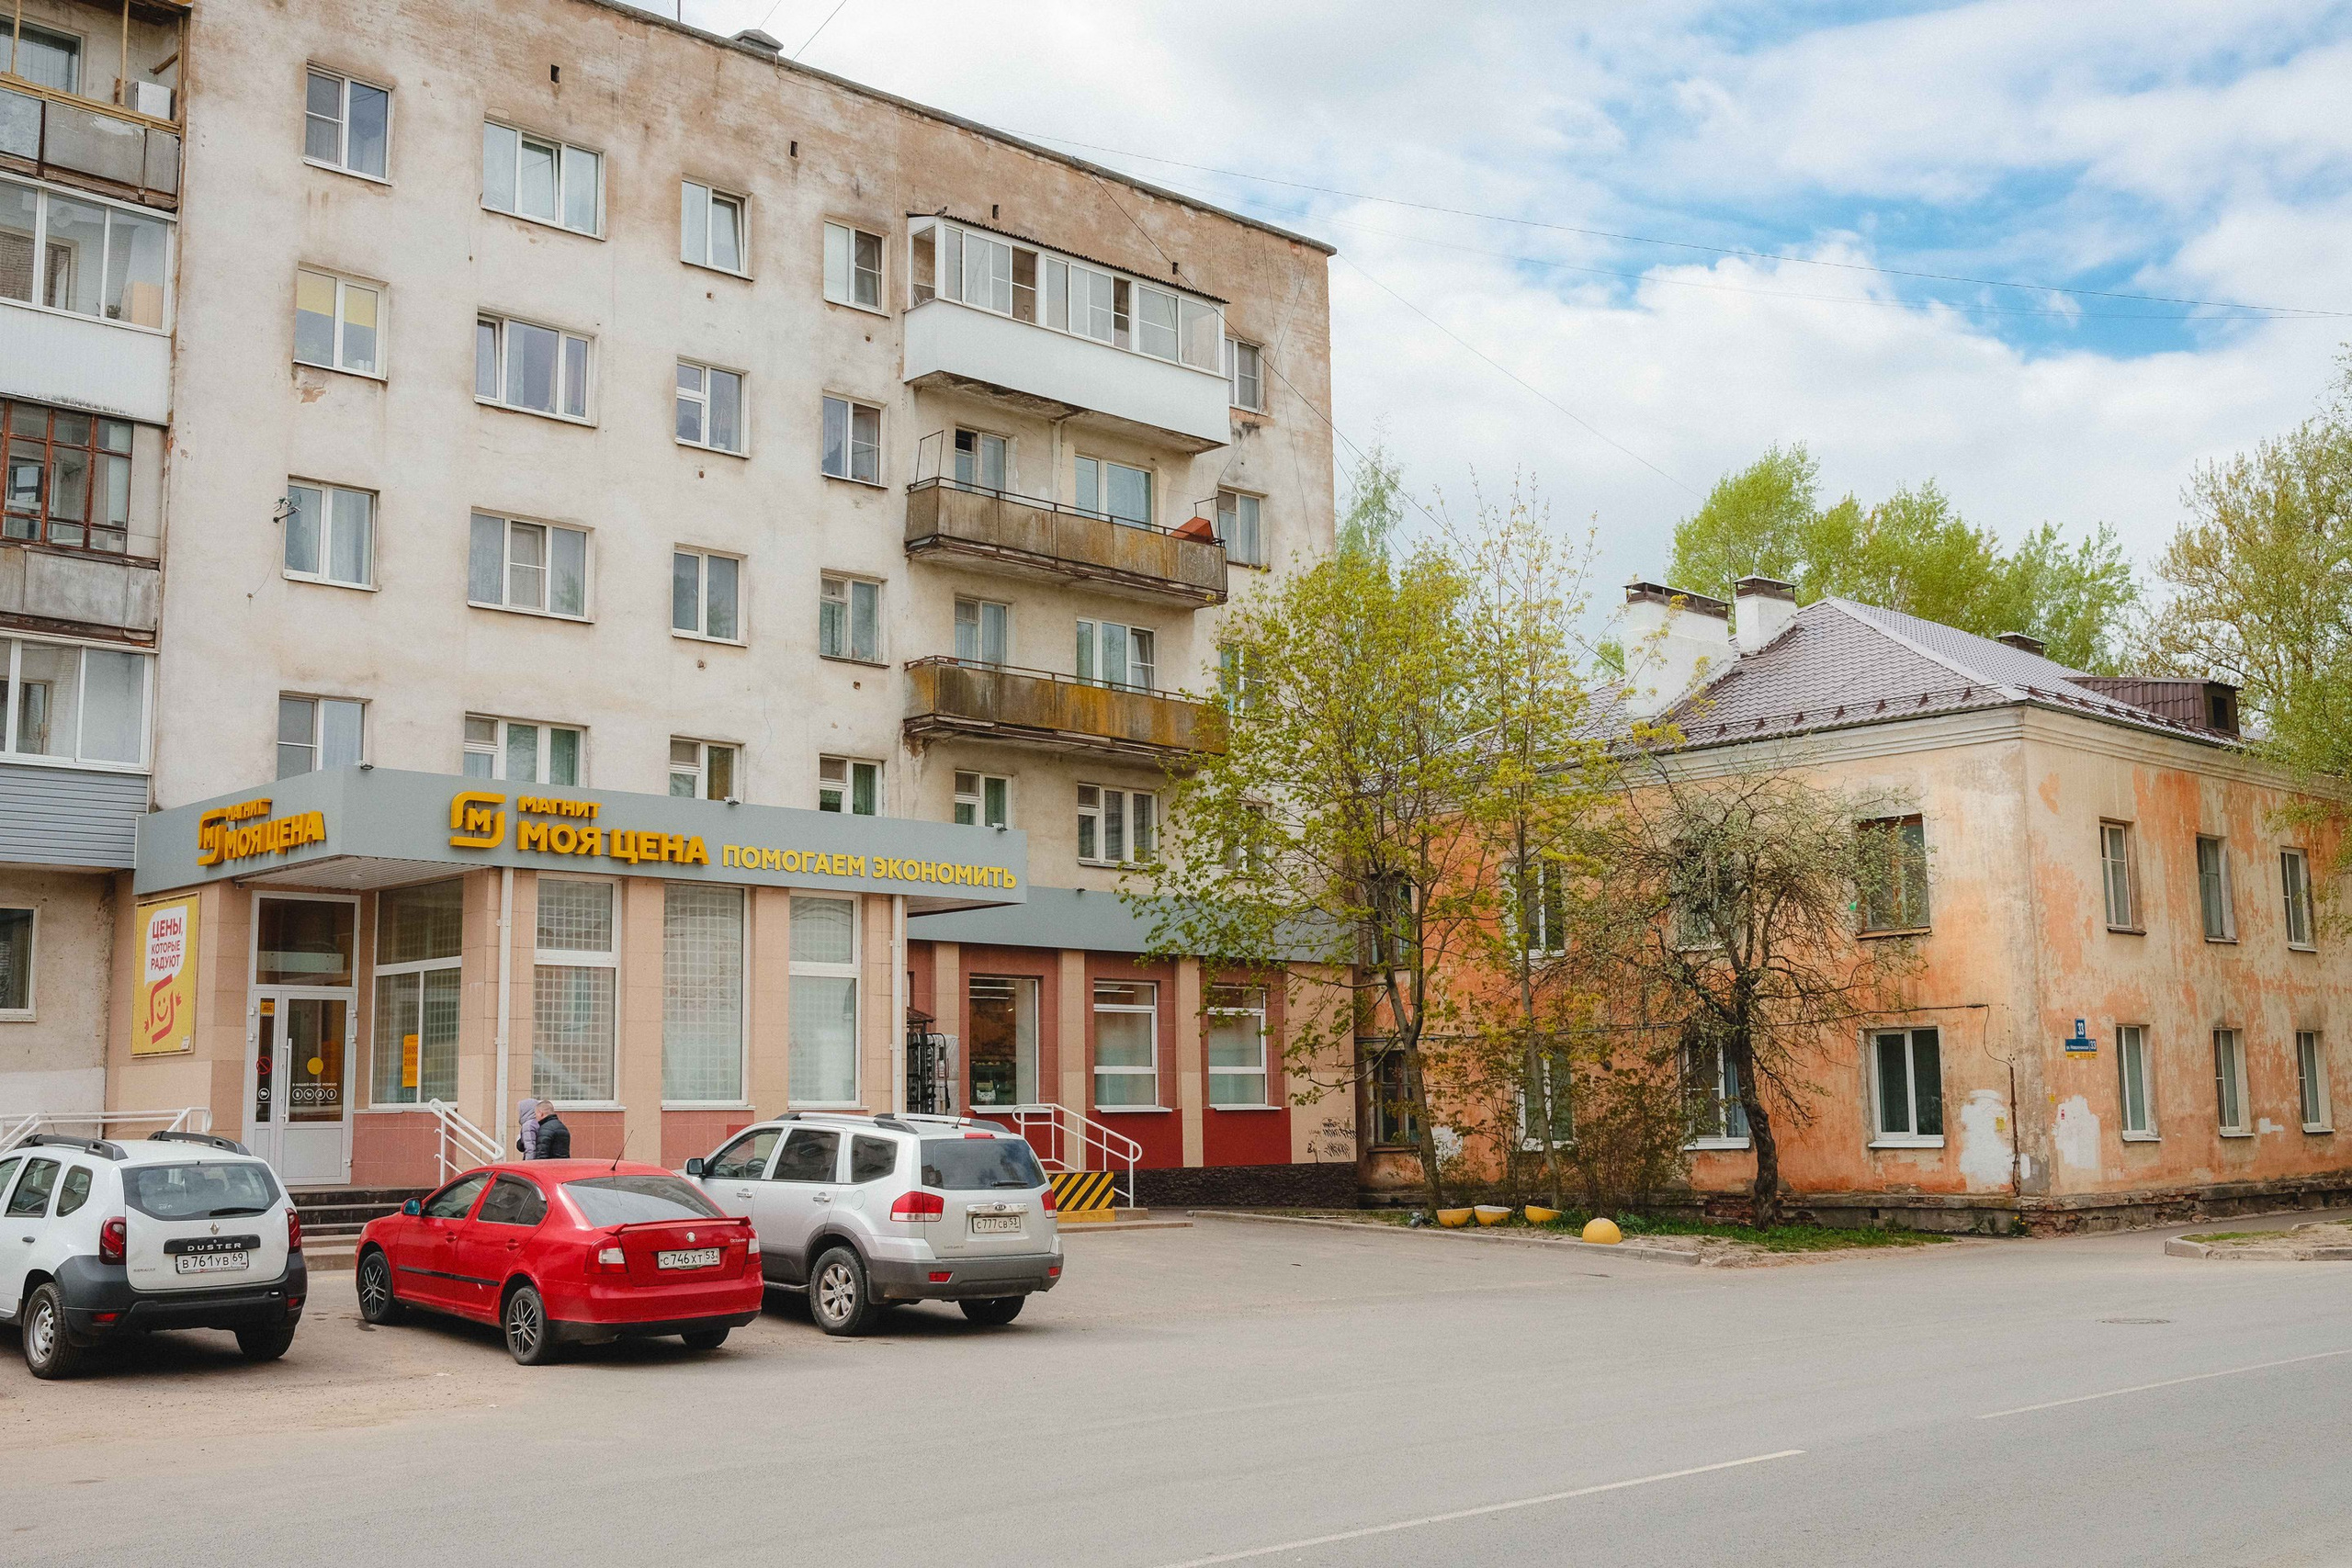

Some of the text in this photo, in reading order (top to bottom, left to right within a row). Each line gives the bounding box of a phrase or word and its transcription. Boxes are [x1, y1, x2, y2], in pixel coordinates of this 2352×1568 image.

[225, 798, 273, 822] МАГНИТ
[517, 795, 602, 819] МАГНИТ
[224, 810, 326, 861] МОЯ ЦЕНА
[517, 820, 711, 865] МОЯ ЦЕНА
[722, 844, 1018, 889] ПОМОГАЕМ ЭКОНОМИТЬ
[152, 917, 183, 942] ЦЕНЫ,
[151, 940, 181, 955] КОТОРЫЕ
[150, 954, 181, 971] РАДУЮТ
[2077, 1021, 2085, 1035] 33
[2089, 1040, 2097, 1050] 33
[187, 1242, 243, 1252] DUSTER
